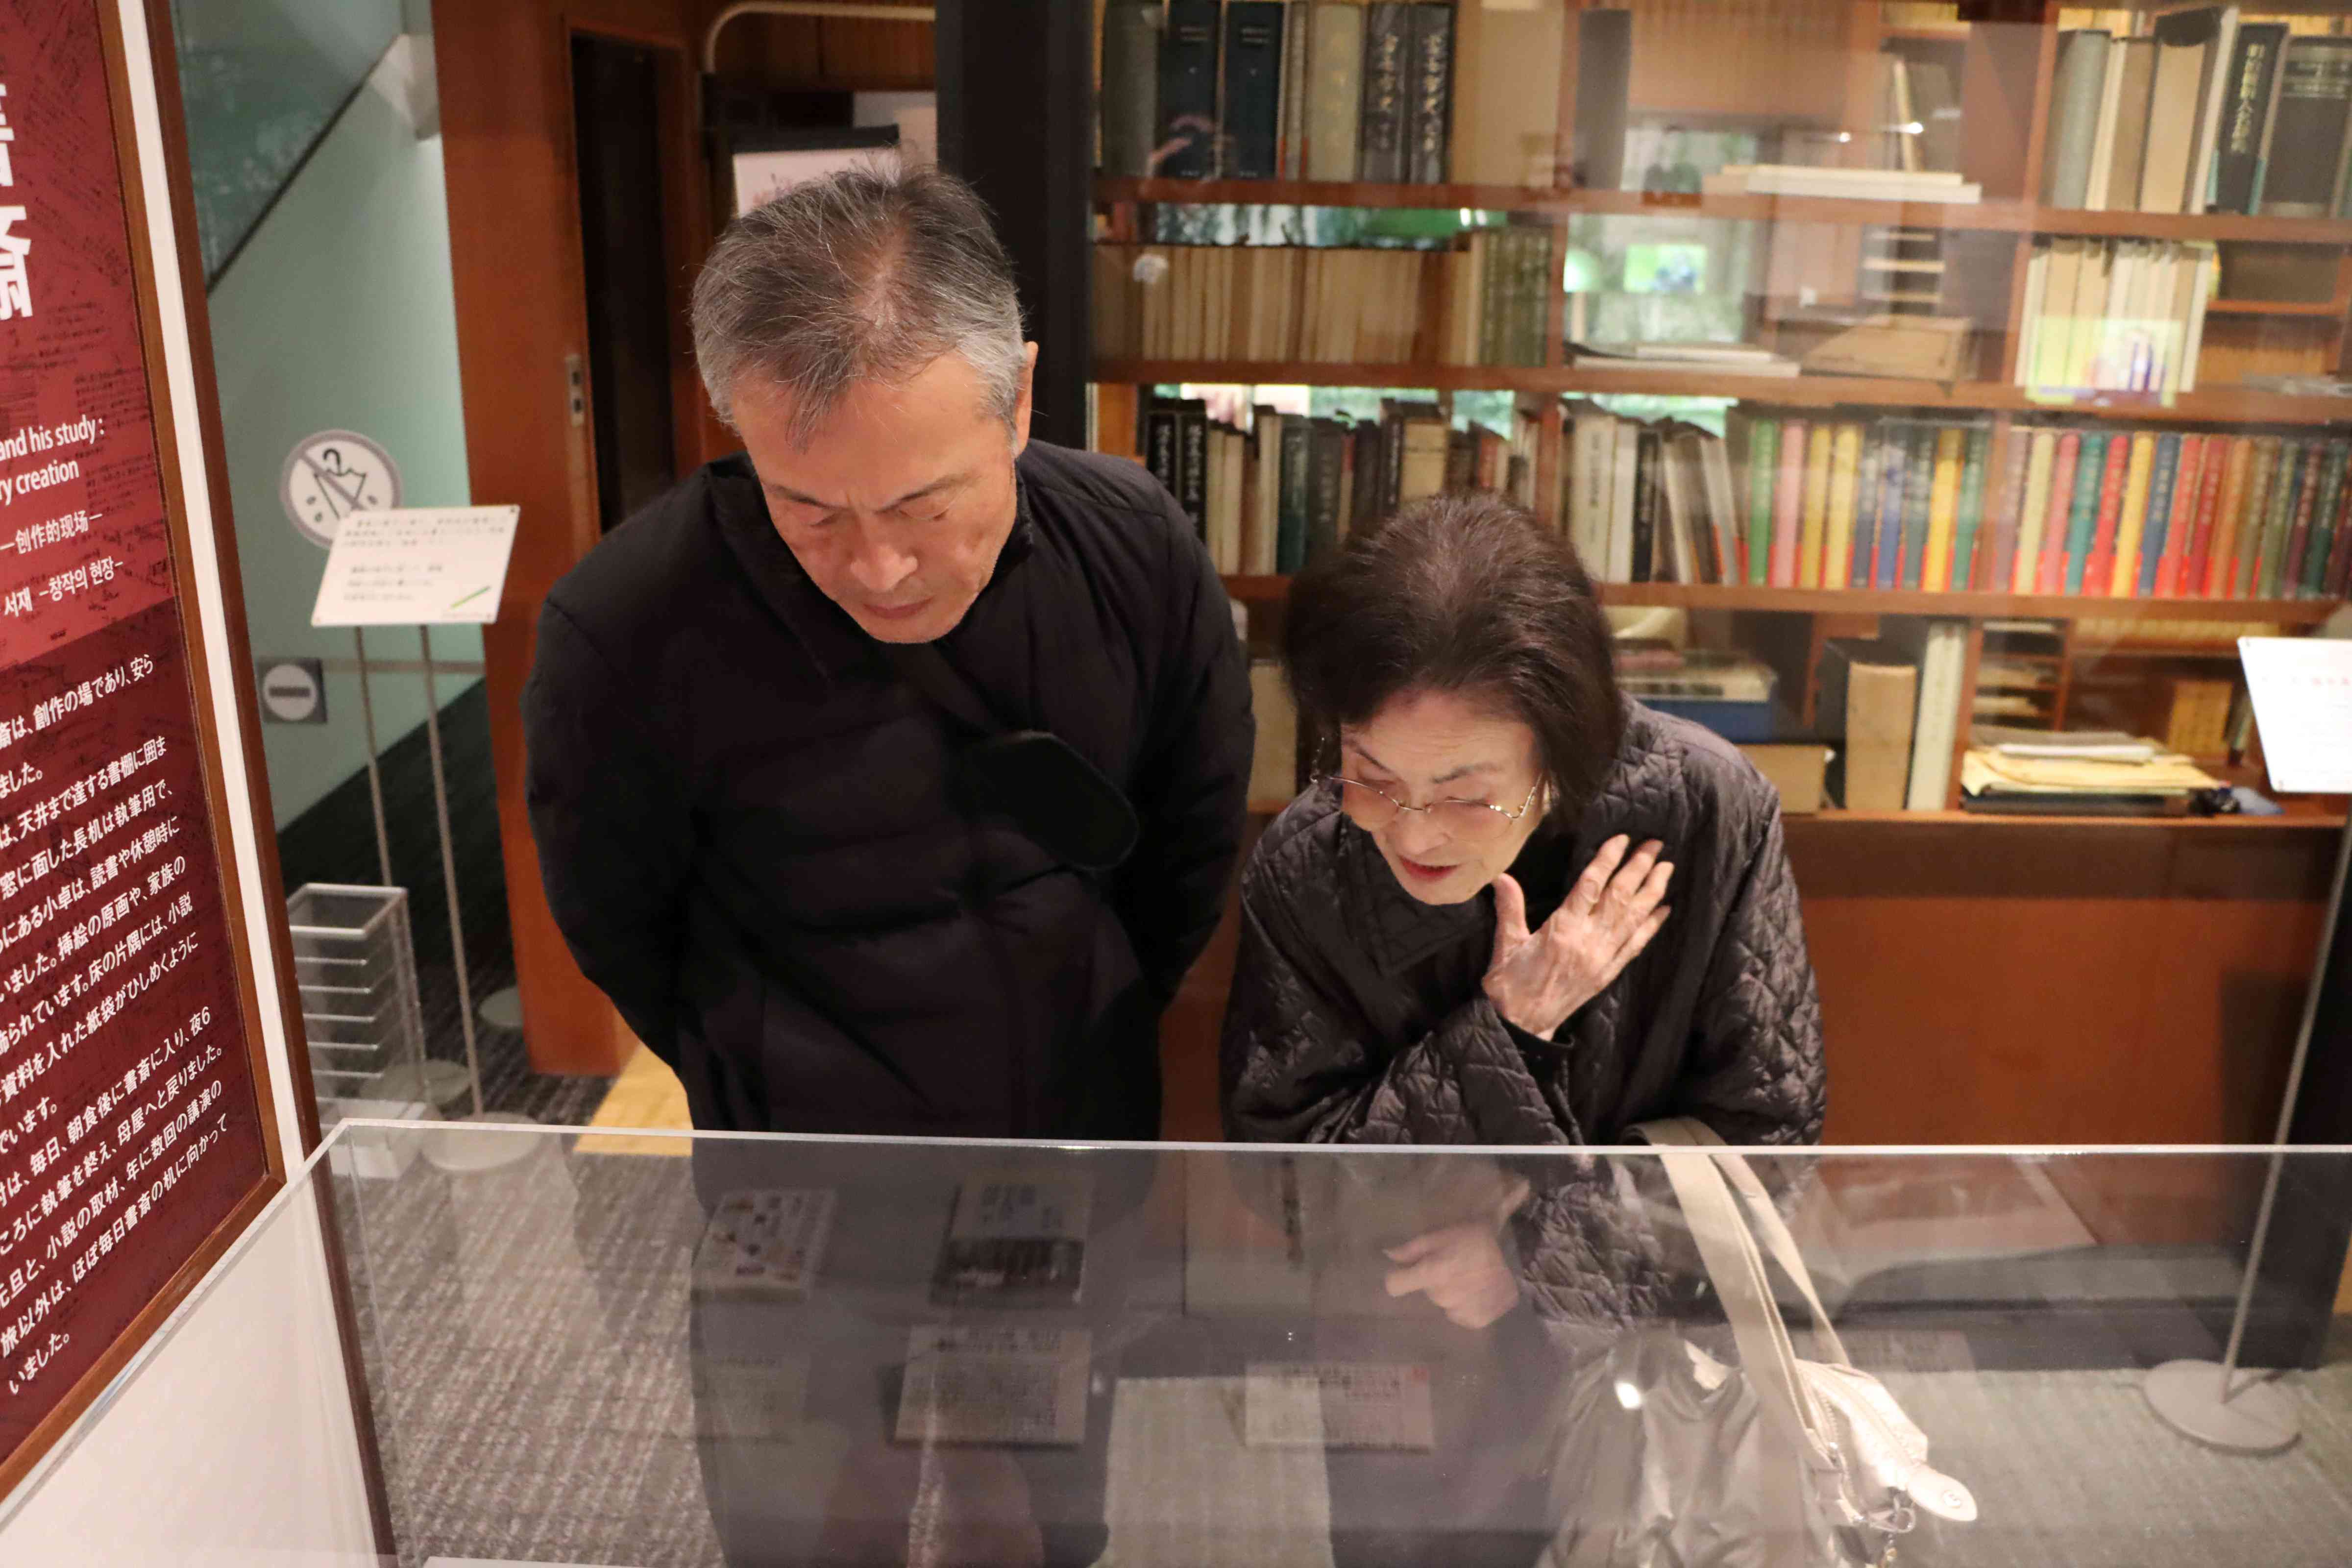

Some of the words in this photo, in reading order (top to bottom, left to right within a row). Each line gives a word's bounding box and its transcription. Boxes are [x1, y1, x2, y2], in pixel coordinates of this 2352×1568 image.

[28, 425, 54, 453] his
[16, 459, 79, 494] creation
[4, 587, 33, 617] 서재
[0, 762, 43, 799] ました。
[0, 815, 180, 955] にある小卓は、読書や休憩時に
[0, 931, 198, 1105] 資料を入れた紙袋がひしめくように
[9, 1333, 70, 1395] いました。
